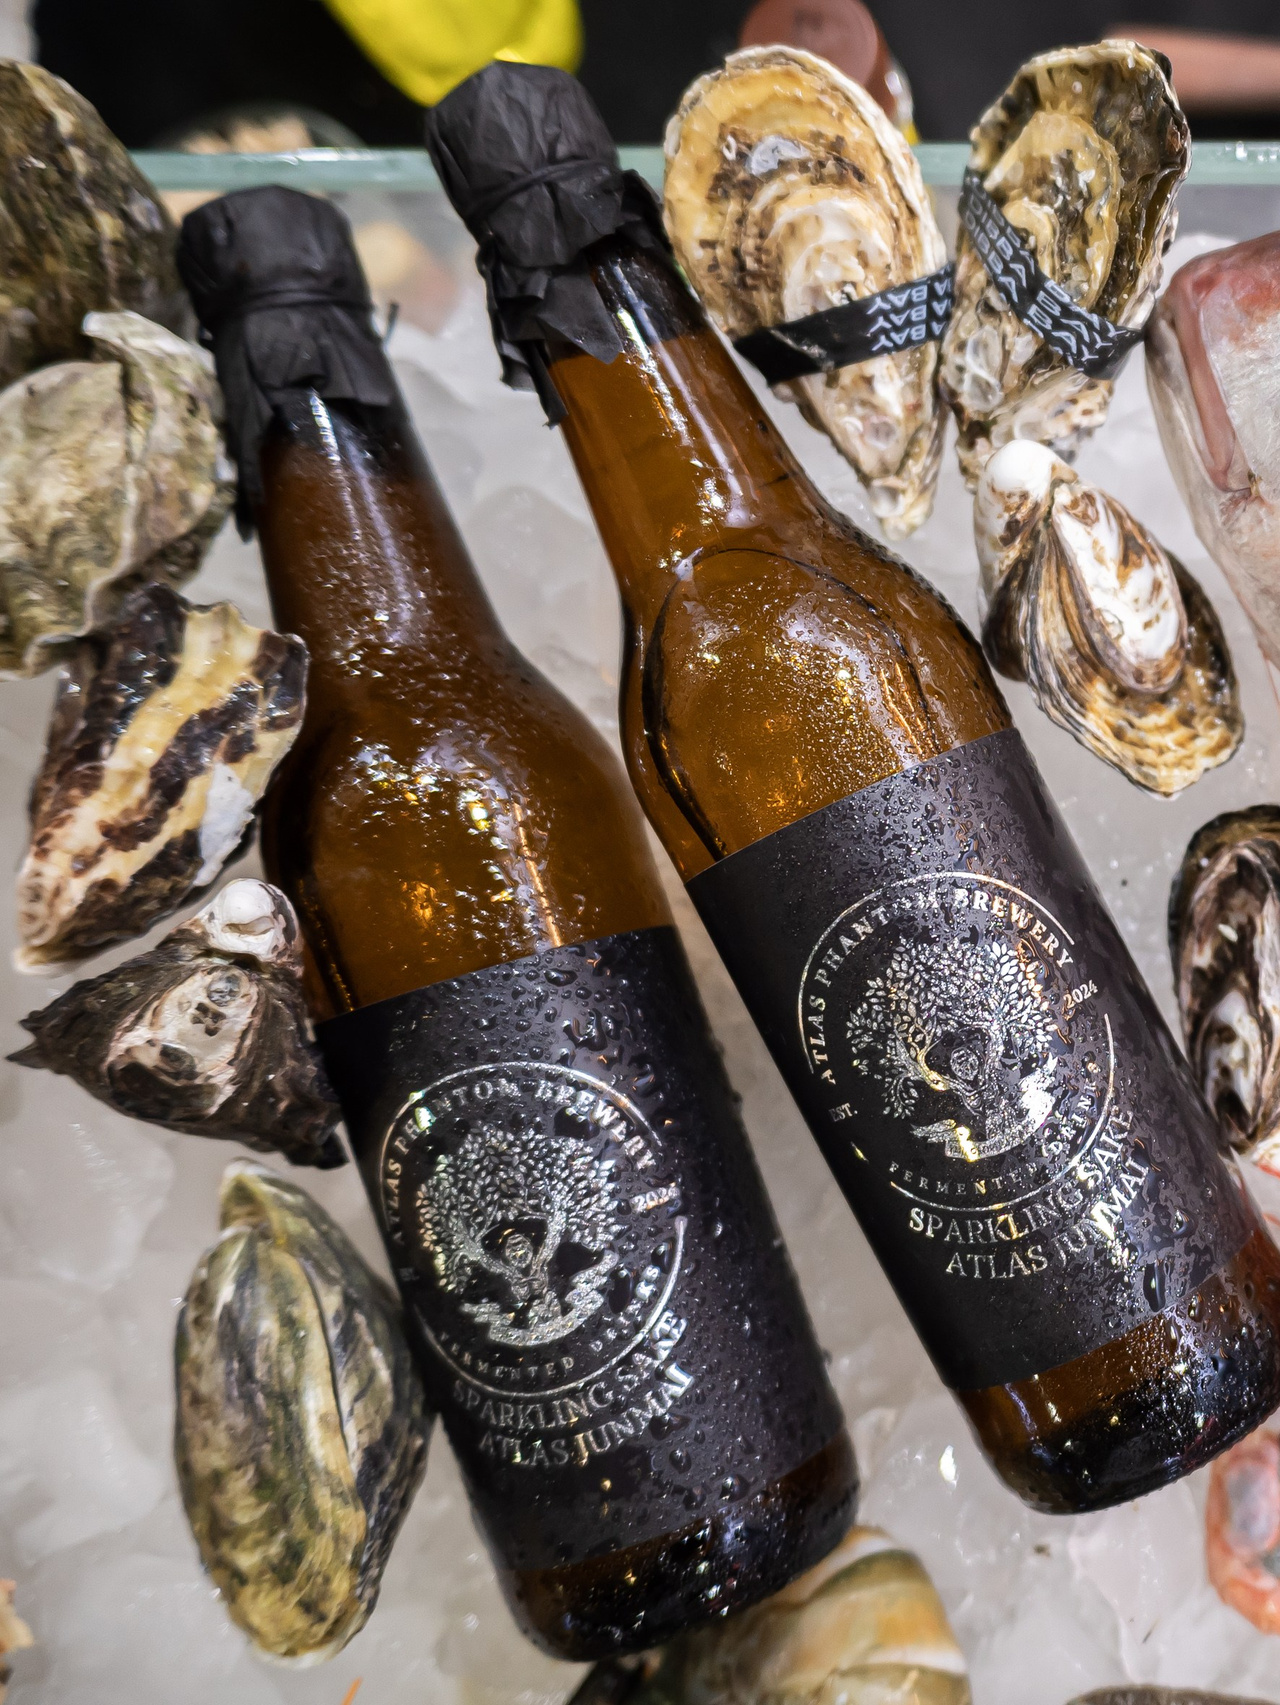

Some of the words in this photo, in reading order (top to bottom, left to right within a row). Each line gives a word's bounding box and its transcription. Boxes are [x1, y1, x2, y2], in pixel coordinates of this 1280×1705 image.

[866, 284, 928, 315] BAY
[965, 209, 1019, 303] DIBBA
[1027, 303, 1099, 361] BAY
[969, 194, 1027, 288] DIBBA
[1036, 290, 1113, 349] BAY
[866, 304, 927, 334] BAY
[872, 324, 926, 351] BAY
[814, 893, 939, 988] PHANT
[952, 888, 1074, 968] BREWERY
[1063, 979, 1099, 1010] 2024
[808, 995, 836, 1085] ATLAS
[394, 1078, 521, 1155] PHNTOM
[888, 1161, 1038, 1196] FERMENTED
[909, 1183, 1084, 1245] SPARKLING
[1077, 1105, 1134, 1188] SAKE
[945, 1245, 1048, 1279] ATLAS
[1054, 1159, 1149, 1266] JUNMAI
[453, 1381, 614, 1428] SPARKLING
[479, 1431, 569, 1467] ATLAS
